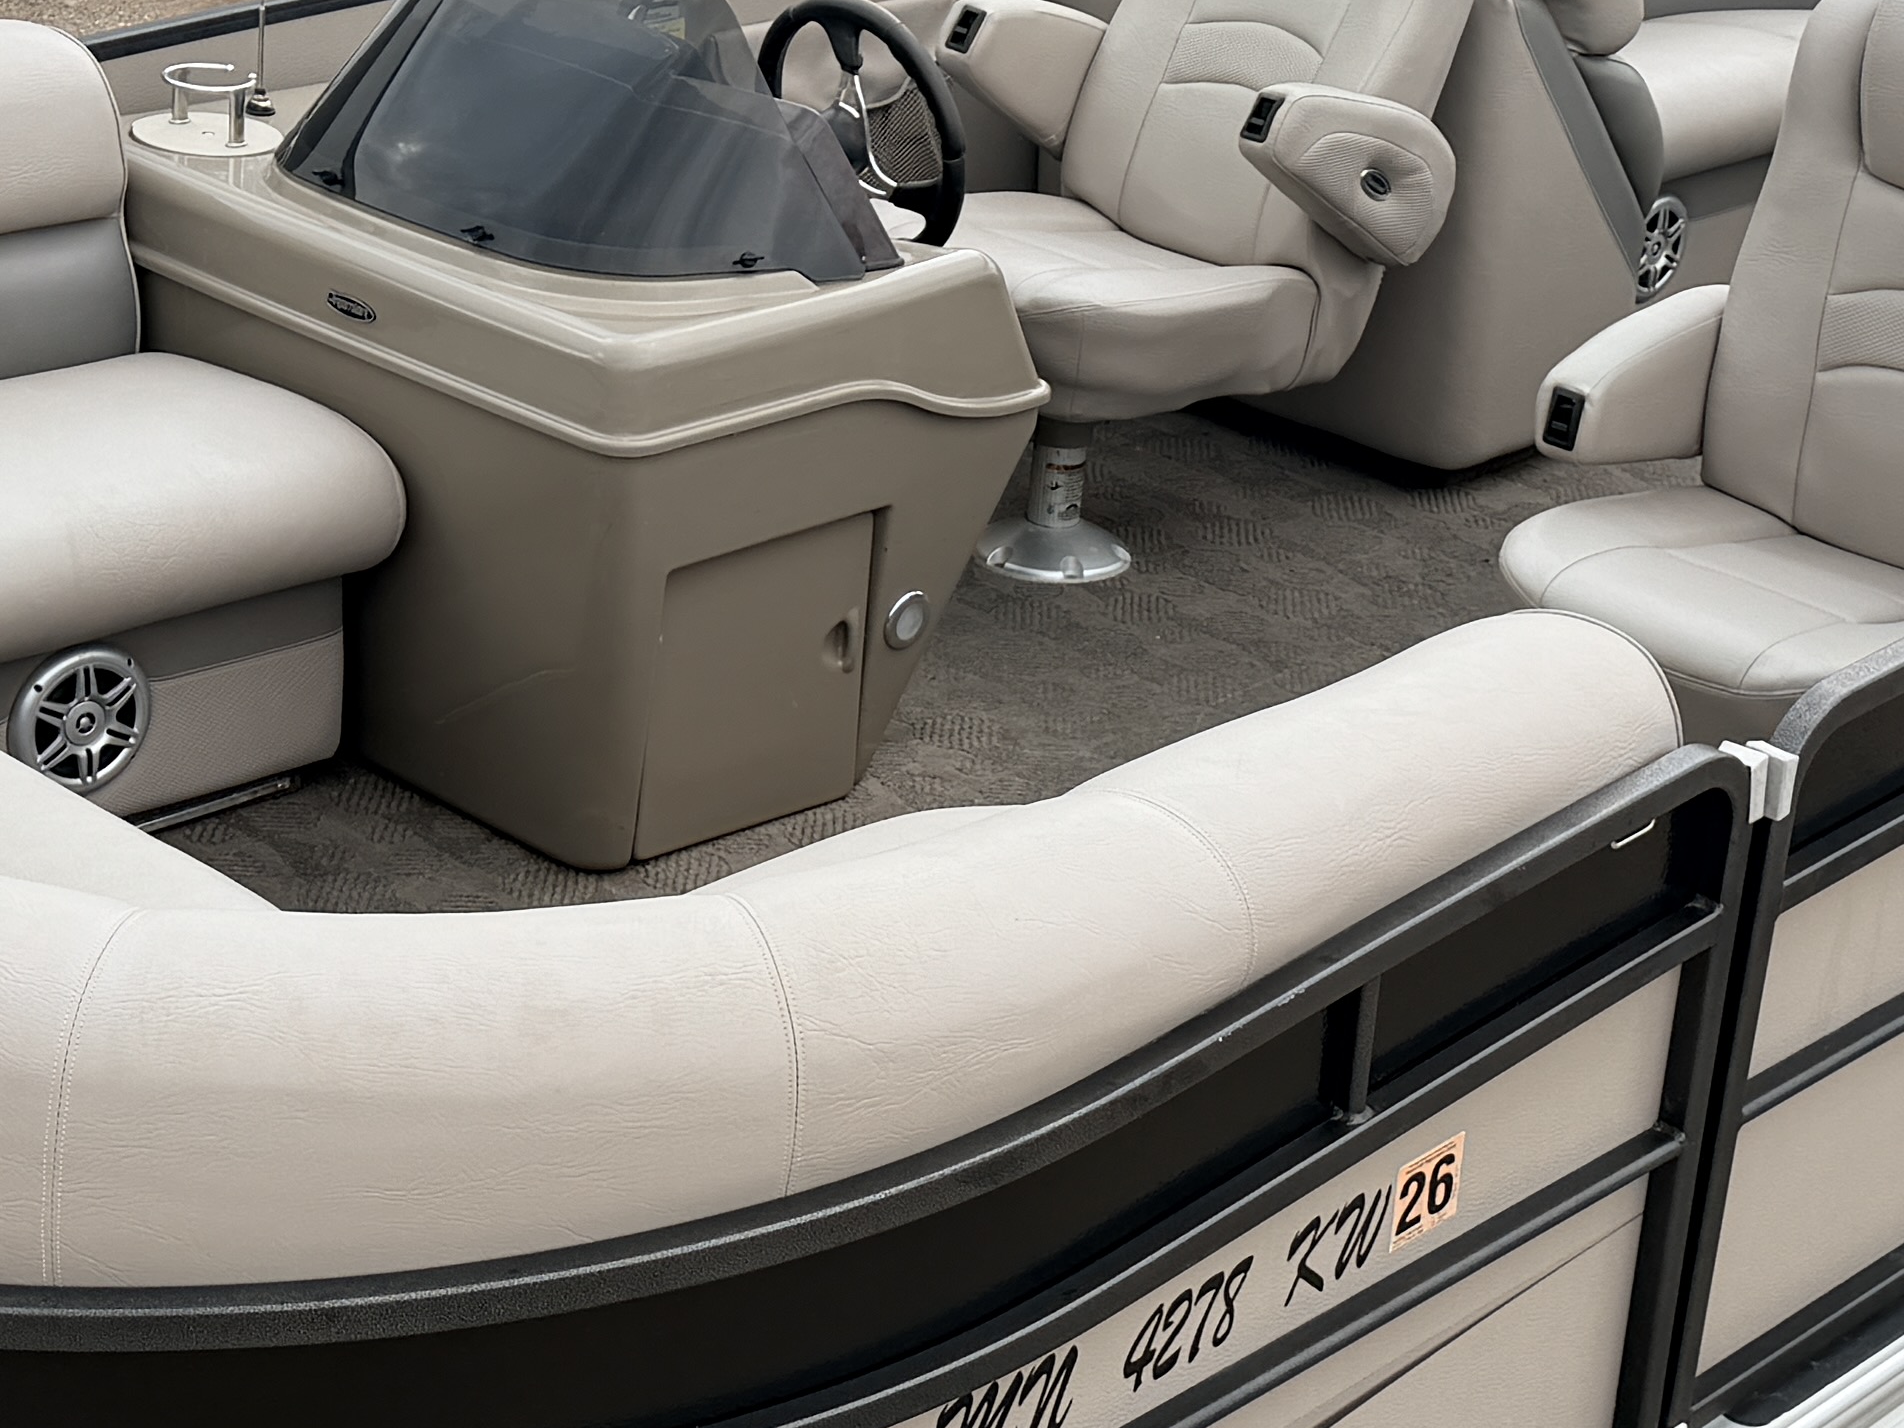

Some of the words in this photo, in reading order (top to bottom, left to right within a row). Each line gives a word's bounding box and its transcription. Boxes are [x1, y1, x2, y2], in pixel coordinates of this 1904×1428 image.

[1395, 1153, 1456, 1237] 26
[1122, 1255, 1255, 1392] 4278
[1284, 1183, 1393, 1307] KW
